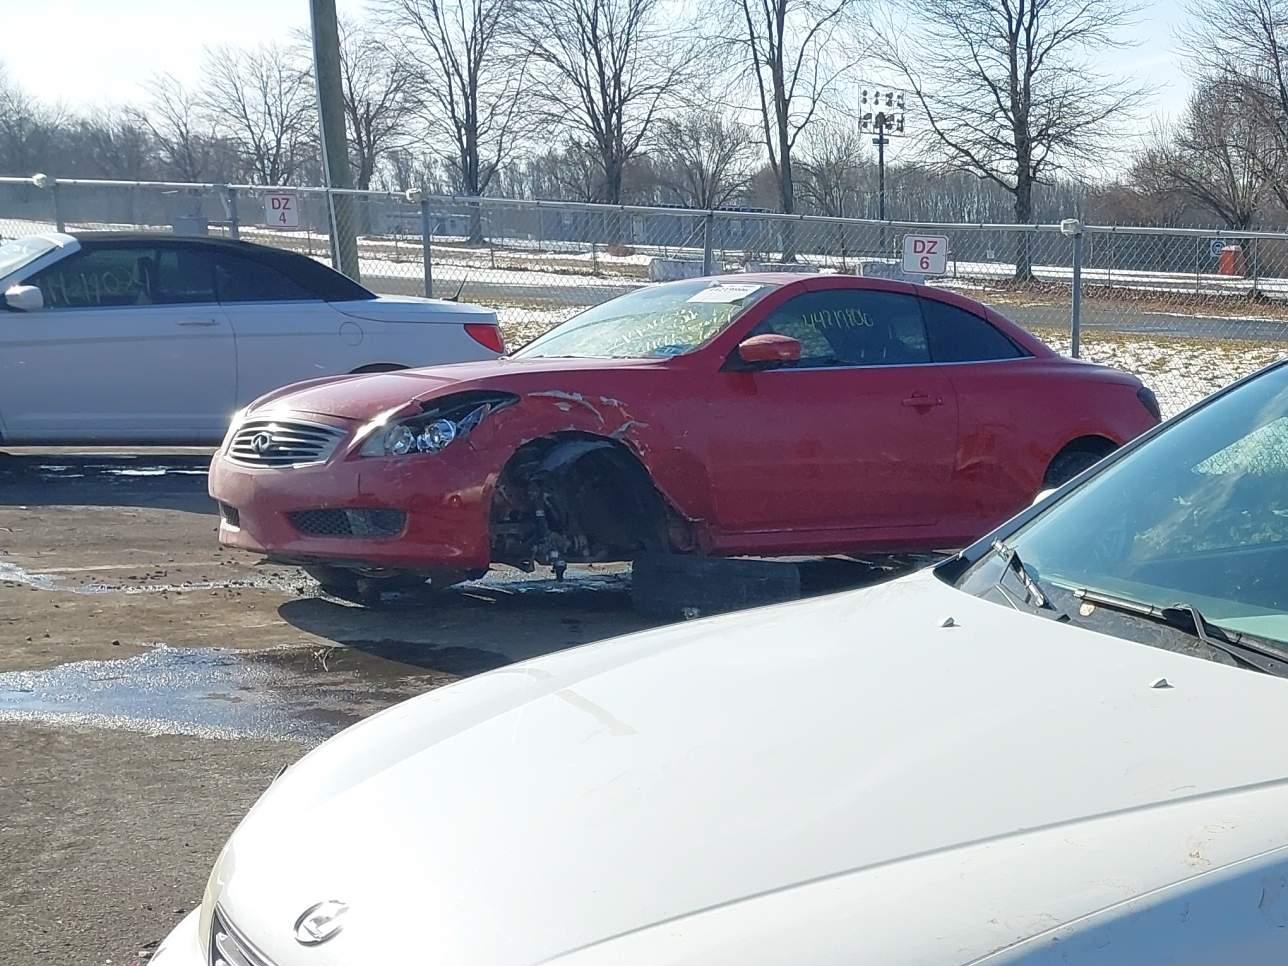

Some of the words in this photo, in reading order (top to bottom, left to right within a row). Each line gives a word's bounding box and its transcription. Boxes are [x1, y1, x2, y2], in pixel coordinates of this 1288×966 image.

[271, 197, 292, 210] DZ
[279, 211, 287, 225] 4
[913, 239, 938, 255] DZ
[920, 256, 930, 270] 6
